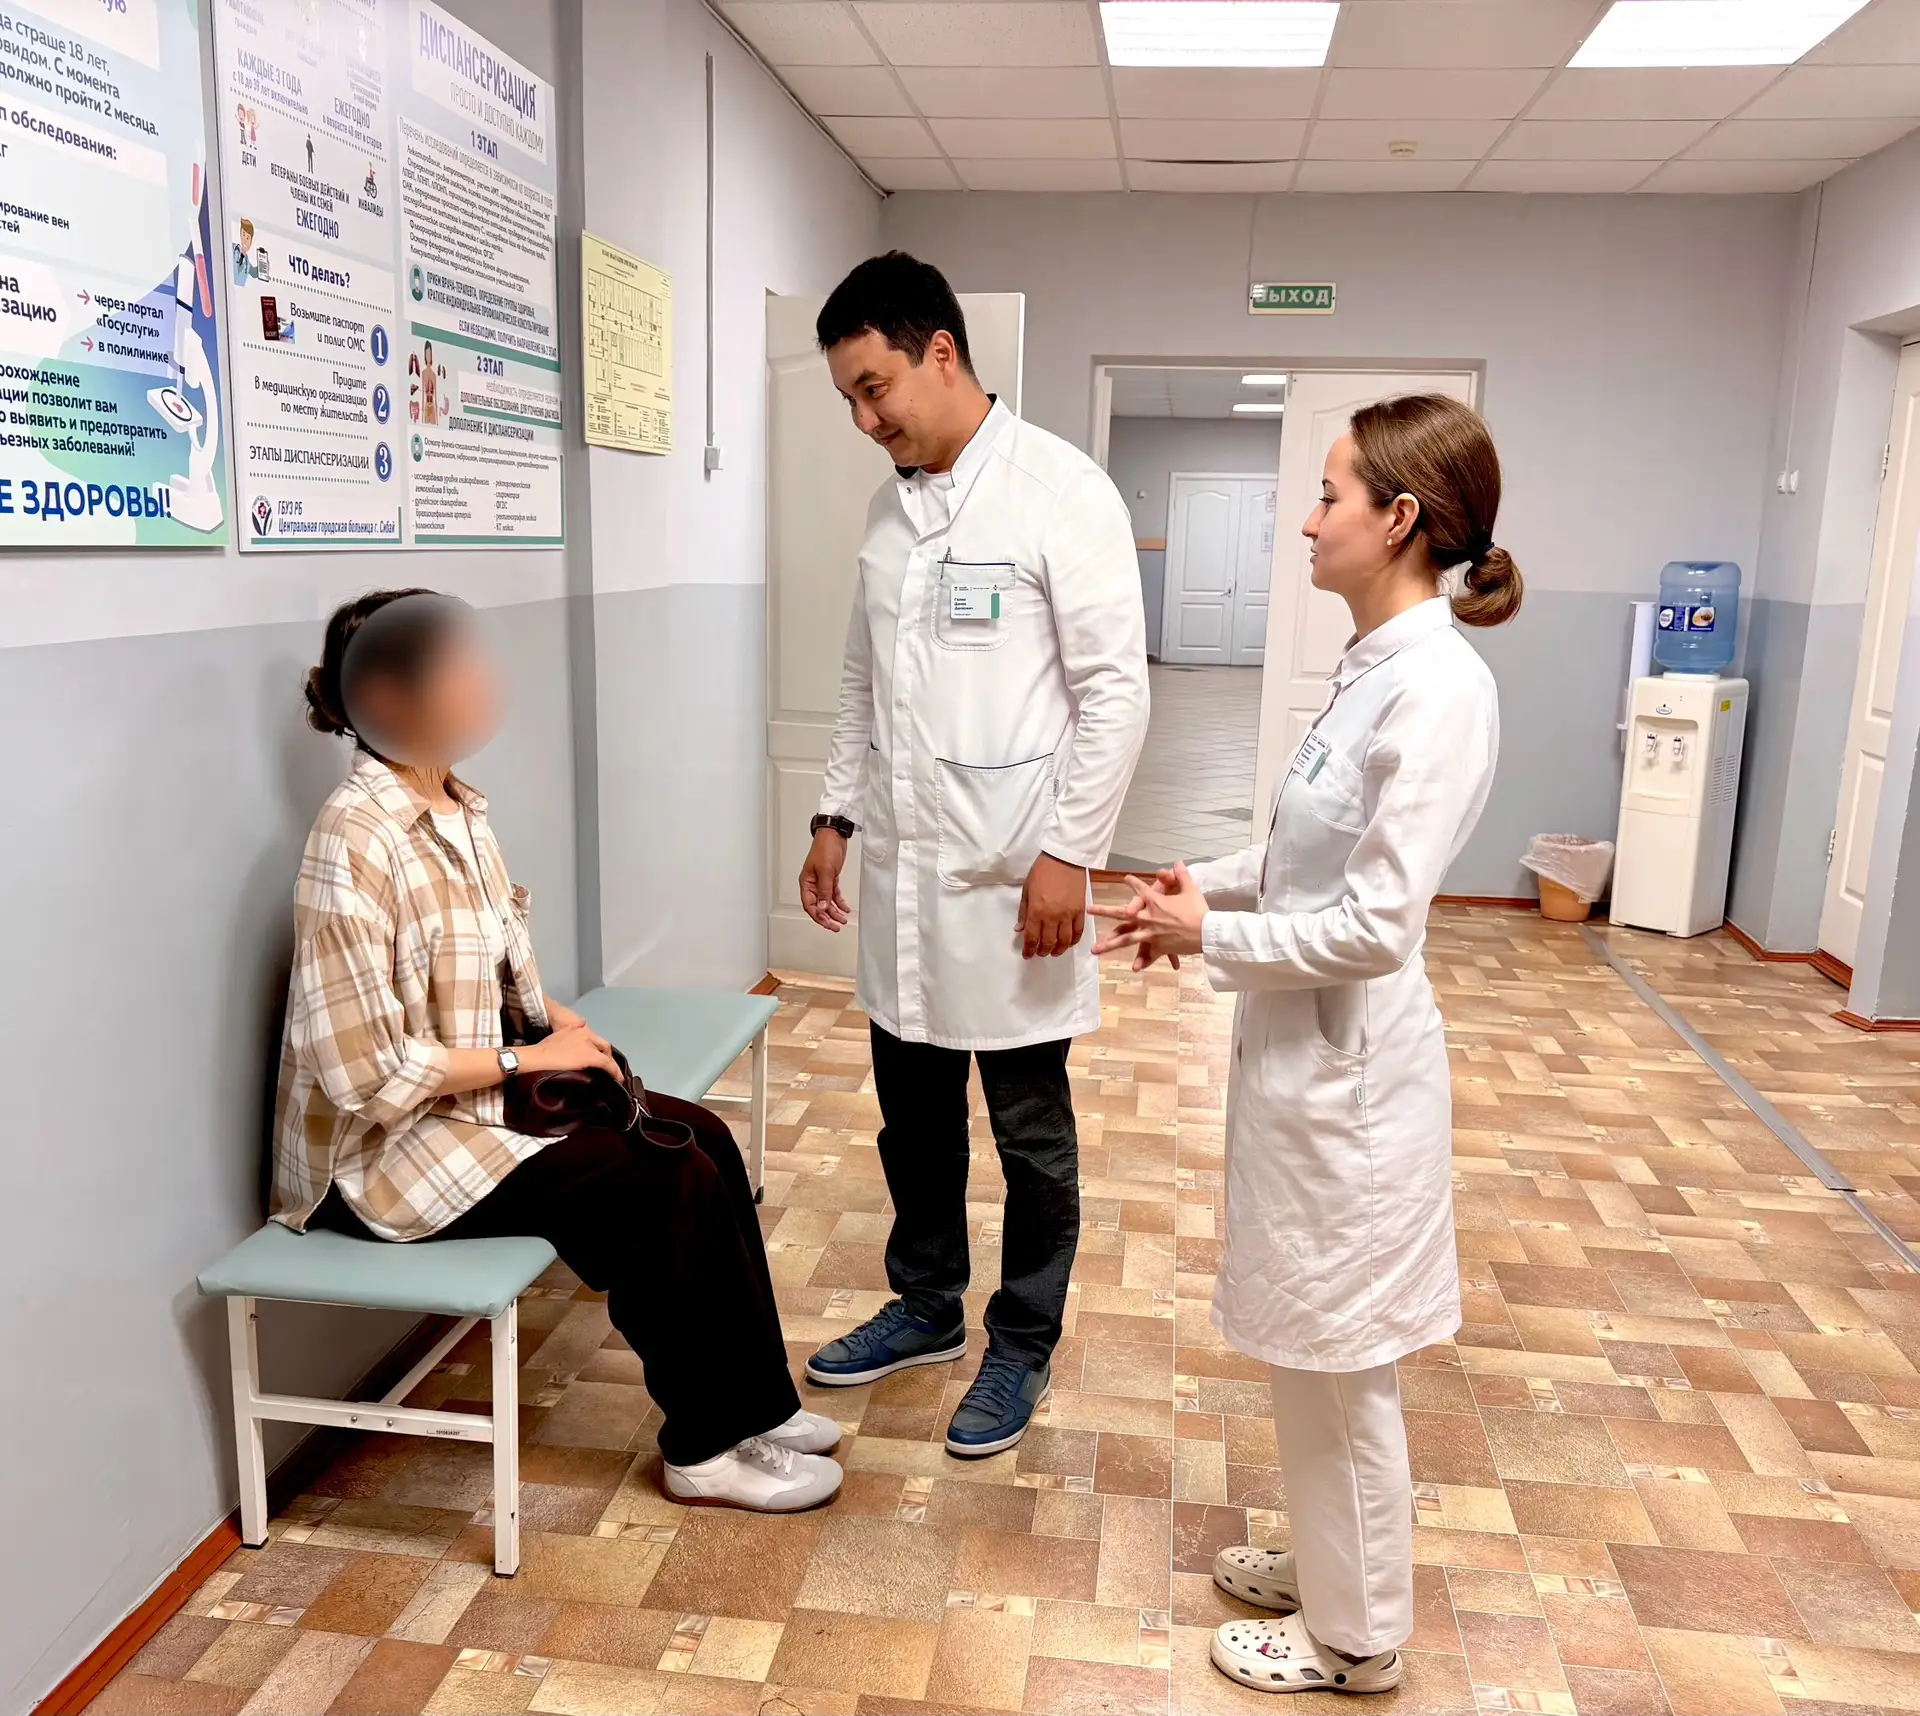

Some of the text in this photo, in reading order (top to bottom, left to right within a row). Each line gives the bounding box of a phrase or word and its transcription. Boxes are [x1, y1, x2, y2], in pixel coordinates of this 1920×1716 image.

[16, 22, 66, 54] страше
[69, 41, 84, 61] 18
[87, 52, 110, 76] лет,
[54, 57, 64, 75] С
[67, 66, 120, 99] момента
[237, 47, 275, 83] КАЖДЫЕ
[282, 70, 303, 97] ГОДА
[0, 61, 159, 136] должно пройти 2 месяца.
[334, 97, 370, 129] ЕЖЕГОДНО
[11, 110, 117, 160] обследования:
[471, 130, 498, 160] 1 ЭТАП
[241, 150, 257, 168] ДЕТИ
[0, 220, 20, 234] тей
[52, 216, 70, 230] вен
[296, 207, 339, 239] ЕЖЕГОДНО
[288, 254, 350, 289] ЧТО делать?
[94, 293, 164, 320] через портал
[290, 301, 365, 334] Возьмите паспорт
[96, 314, 160, 339] «Госуслуги»
[98, 342, 105, 352] в
[317, 332, 366, 353] и полис ОМС
[375, 331, 385, 360] 1
[332, 371, 367, 390] Придите
[477, 356, 504, 377] 2 ЭТАП
[32, 392, 91, 411] позволит
[95, 400, 117, 413] вам
[254, 375, 367, 407] В медицинскую организацию
[377, 390, 387, 418] 2
[10, 412, 66, 429] выявить
[69, 418, 77, 430] и
[80, 420, 168, 440] предотвратить
[280, 402, 368, 424] по месту жительства
[52, 436, 136, 457] заболеваний!
[249, 445, 370, 470] ЭТАПЫ ДИСПАНСЕРИЗАЦИИ
[379, 446, 389, 475] 3
[21, 480, 171, 521] ЗДОРОВЫ!
[278, 501, 293, 515] ГБУЗ
[294, 501, 303, 516] РБ
